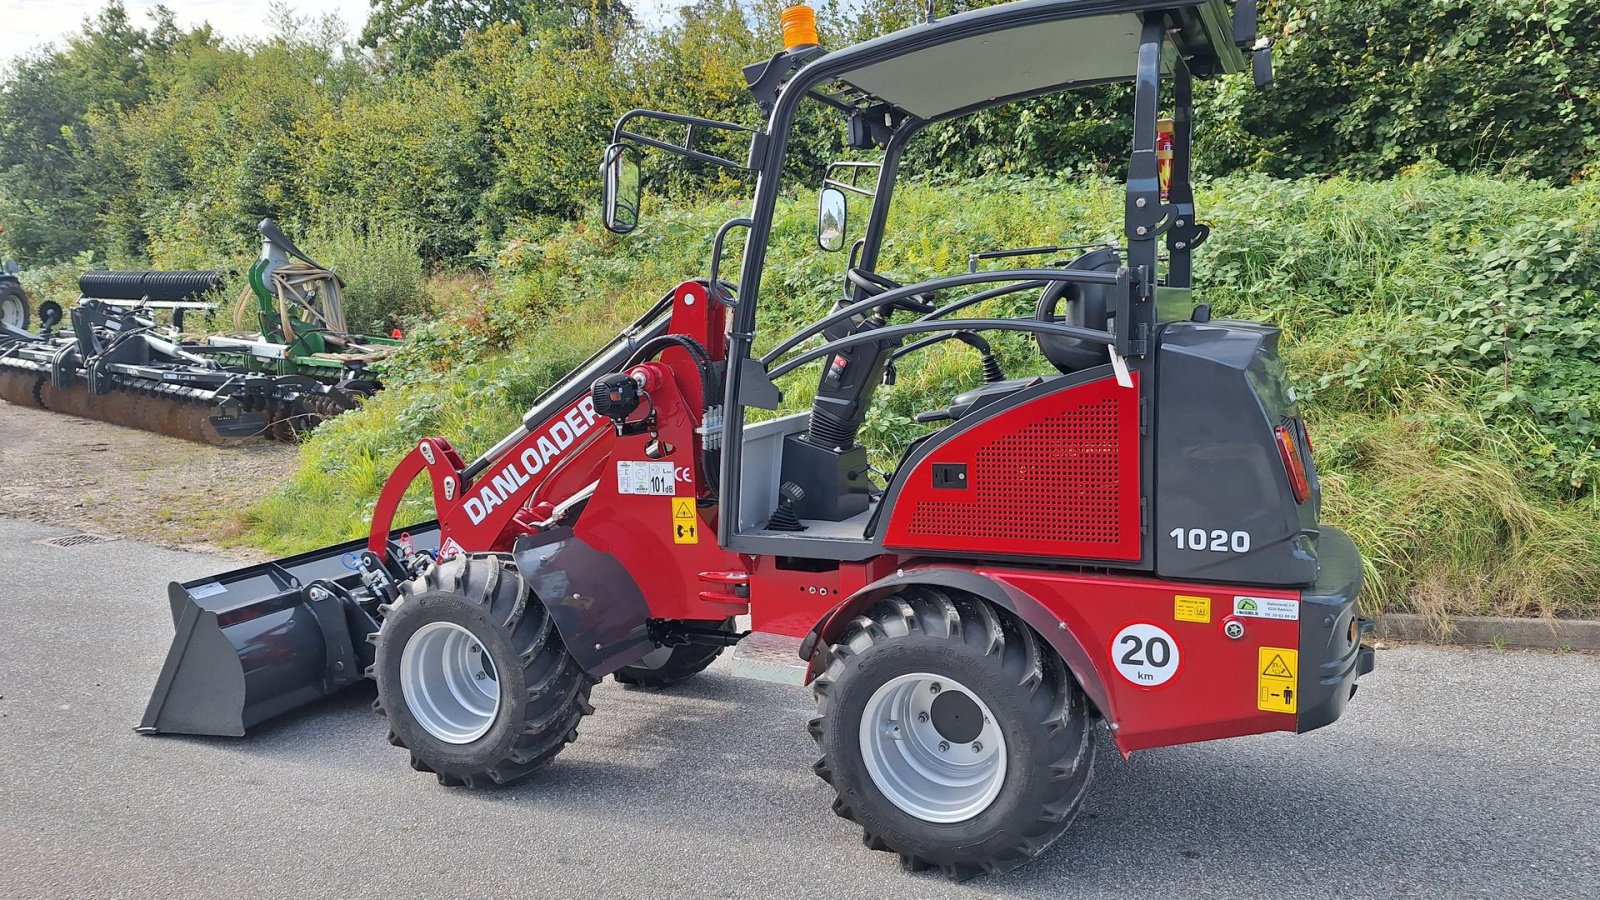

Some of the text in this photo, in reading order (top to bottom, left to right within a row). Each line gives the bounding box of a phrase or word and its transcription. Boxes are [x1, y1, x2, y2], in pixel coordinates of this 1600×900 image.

[462, 395, 602, 526] DANLOADER
[651, 476, 674, 494] 101 dB
[674, 466, 692, 483] CE
[1169, 527, 1251, 553] 1020
[1120, 635, 1171, 668] 20
[1137, 671, 1154, 681] km
